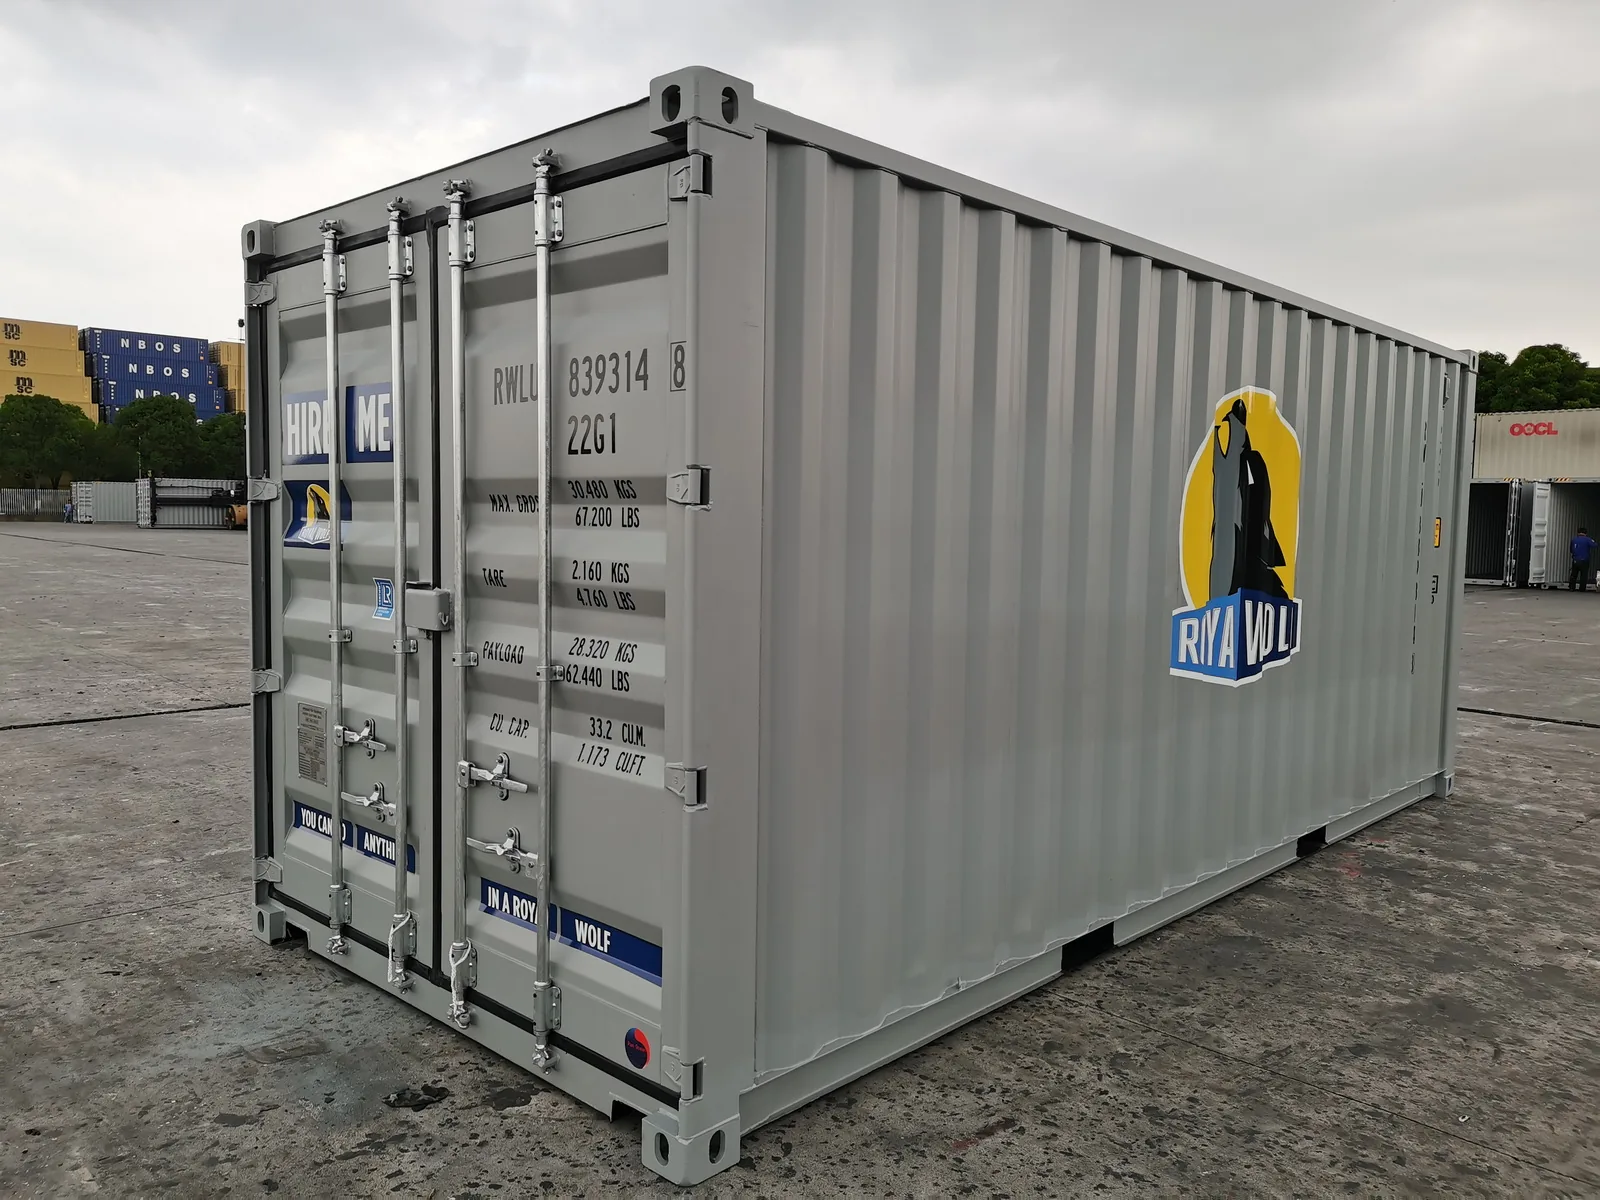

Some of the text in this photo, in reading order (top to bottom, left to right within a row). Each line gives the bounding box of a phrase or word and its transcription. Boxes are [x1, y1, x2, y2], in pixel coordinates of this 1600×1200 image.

[121, 338, 181, 353] NBOS
[129, 363, 189, 378] NBOS
[494, 344, 685, 405] RWLU 839314 8
[358, 393, 391, 453] ME
[567, 412, 616, 455] 22G1
[1509, 422, 1558, 436] OOCL
[613, 480, 637, 500] KGS
[489, 494, 514, 513] MAX.
[621, 507, 640, 528] LBS
[482, 568, 507, 588] TARE
[611, 562, 630, 584] KGS
[613, 590, 636, 611] LBS
[482, 640, 525, 665] PAYLOAD
[615, 642, 638, 664] KGS
[612, 669, 630, 692] LBS
[489, 712, 530, 739] CU. CAP.
[589, 716, 612, 741] 33.2
[300, 807, 316, 830] YOU
[317, 814, 332, 836] CAN
[363, 831, 396, 861] ANYTHI
[487, 886, 500, 911] IN
[502, 892, 510, 914] A
[574, 918, 611, 953] WOLF
